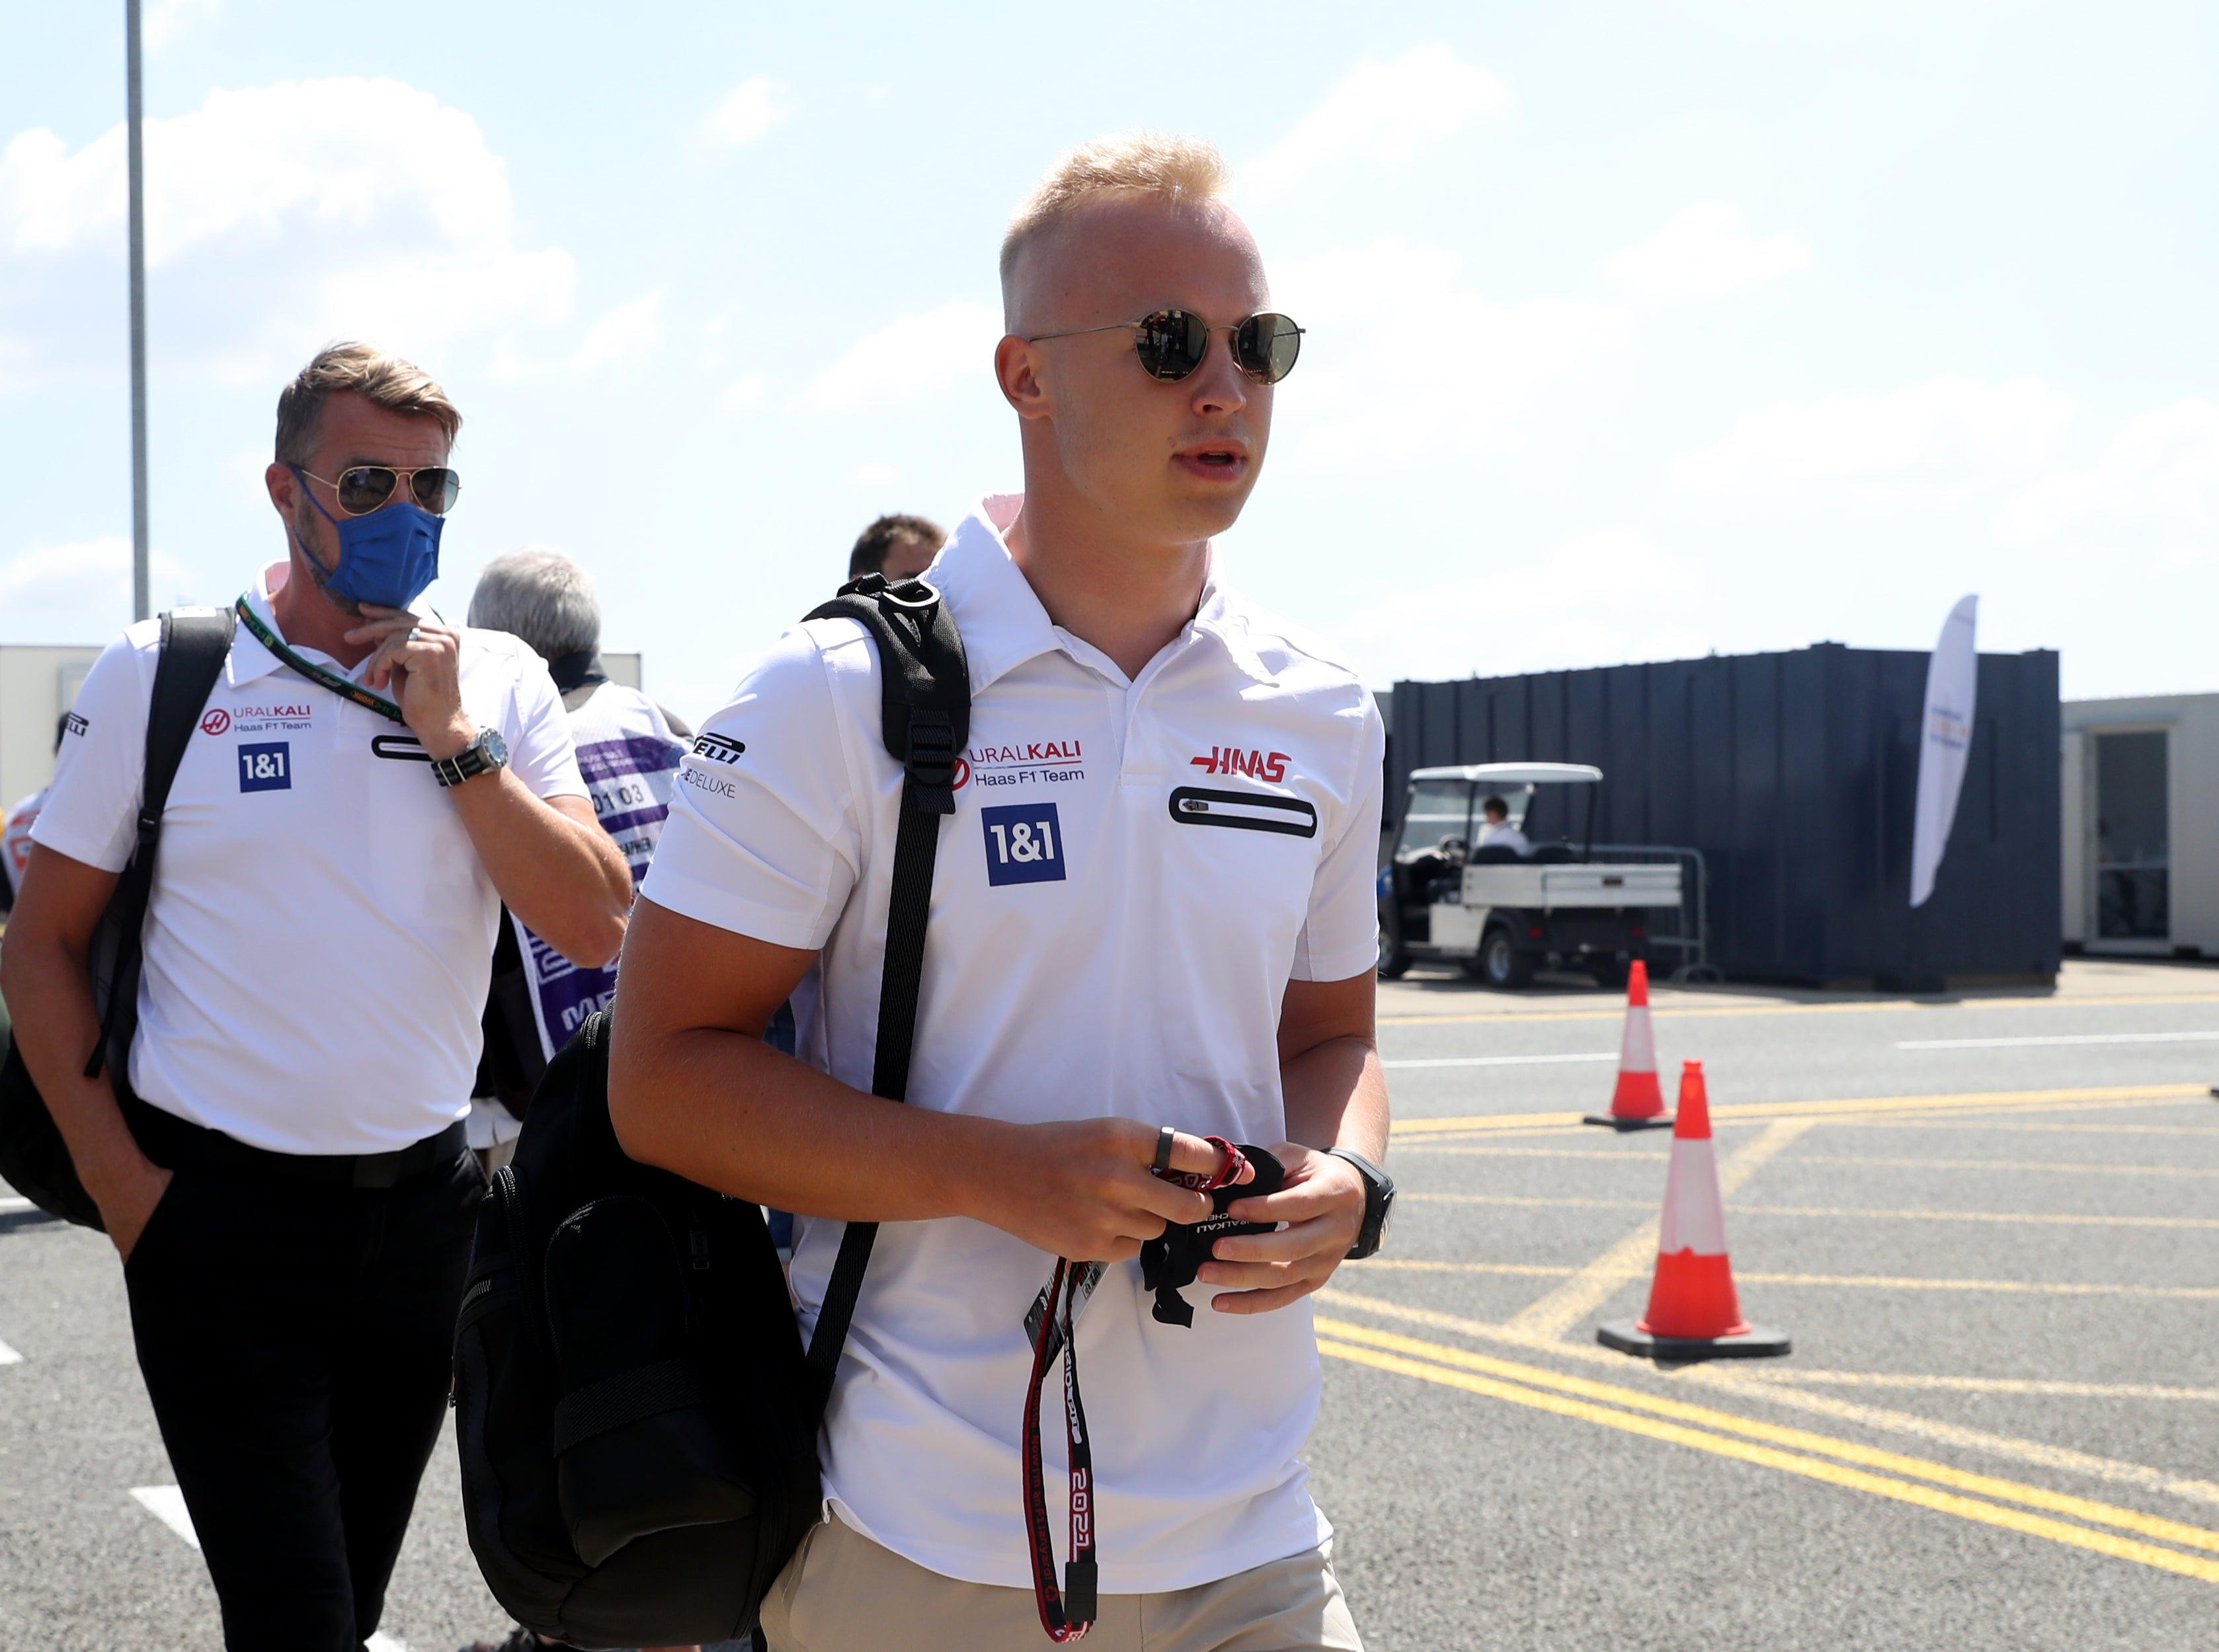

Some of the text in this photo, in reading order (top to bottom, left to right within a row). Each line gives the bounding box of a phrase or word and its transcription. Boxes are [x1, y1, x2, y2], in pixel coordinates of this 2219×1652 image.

[233, 705, 311, 719] URALKALI
[969, 740, 1082, 763] URALKALI
[243, 752, 284, 779] 1&1
[1190, 746, 1292, 783] HAAS
[975, 773, 1017, 786] Haas
[1040, 769, 1084, 783] Team
[990, 820, 1055, 864] 1&1
[1196, 1220, 1250, 1234] RALKALI
